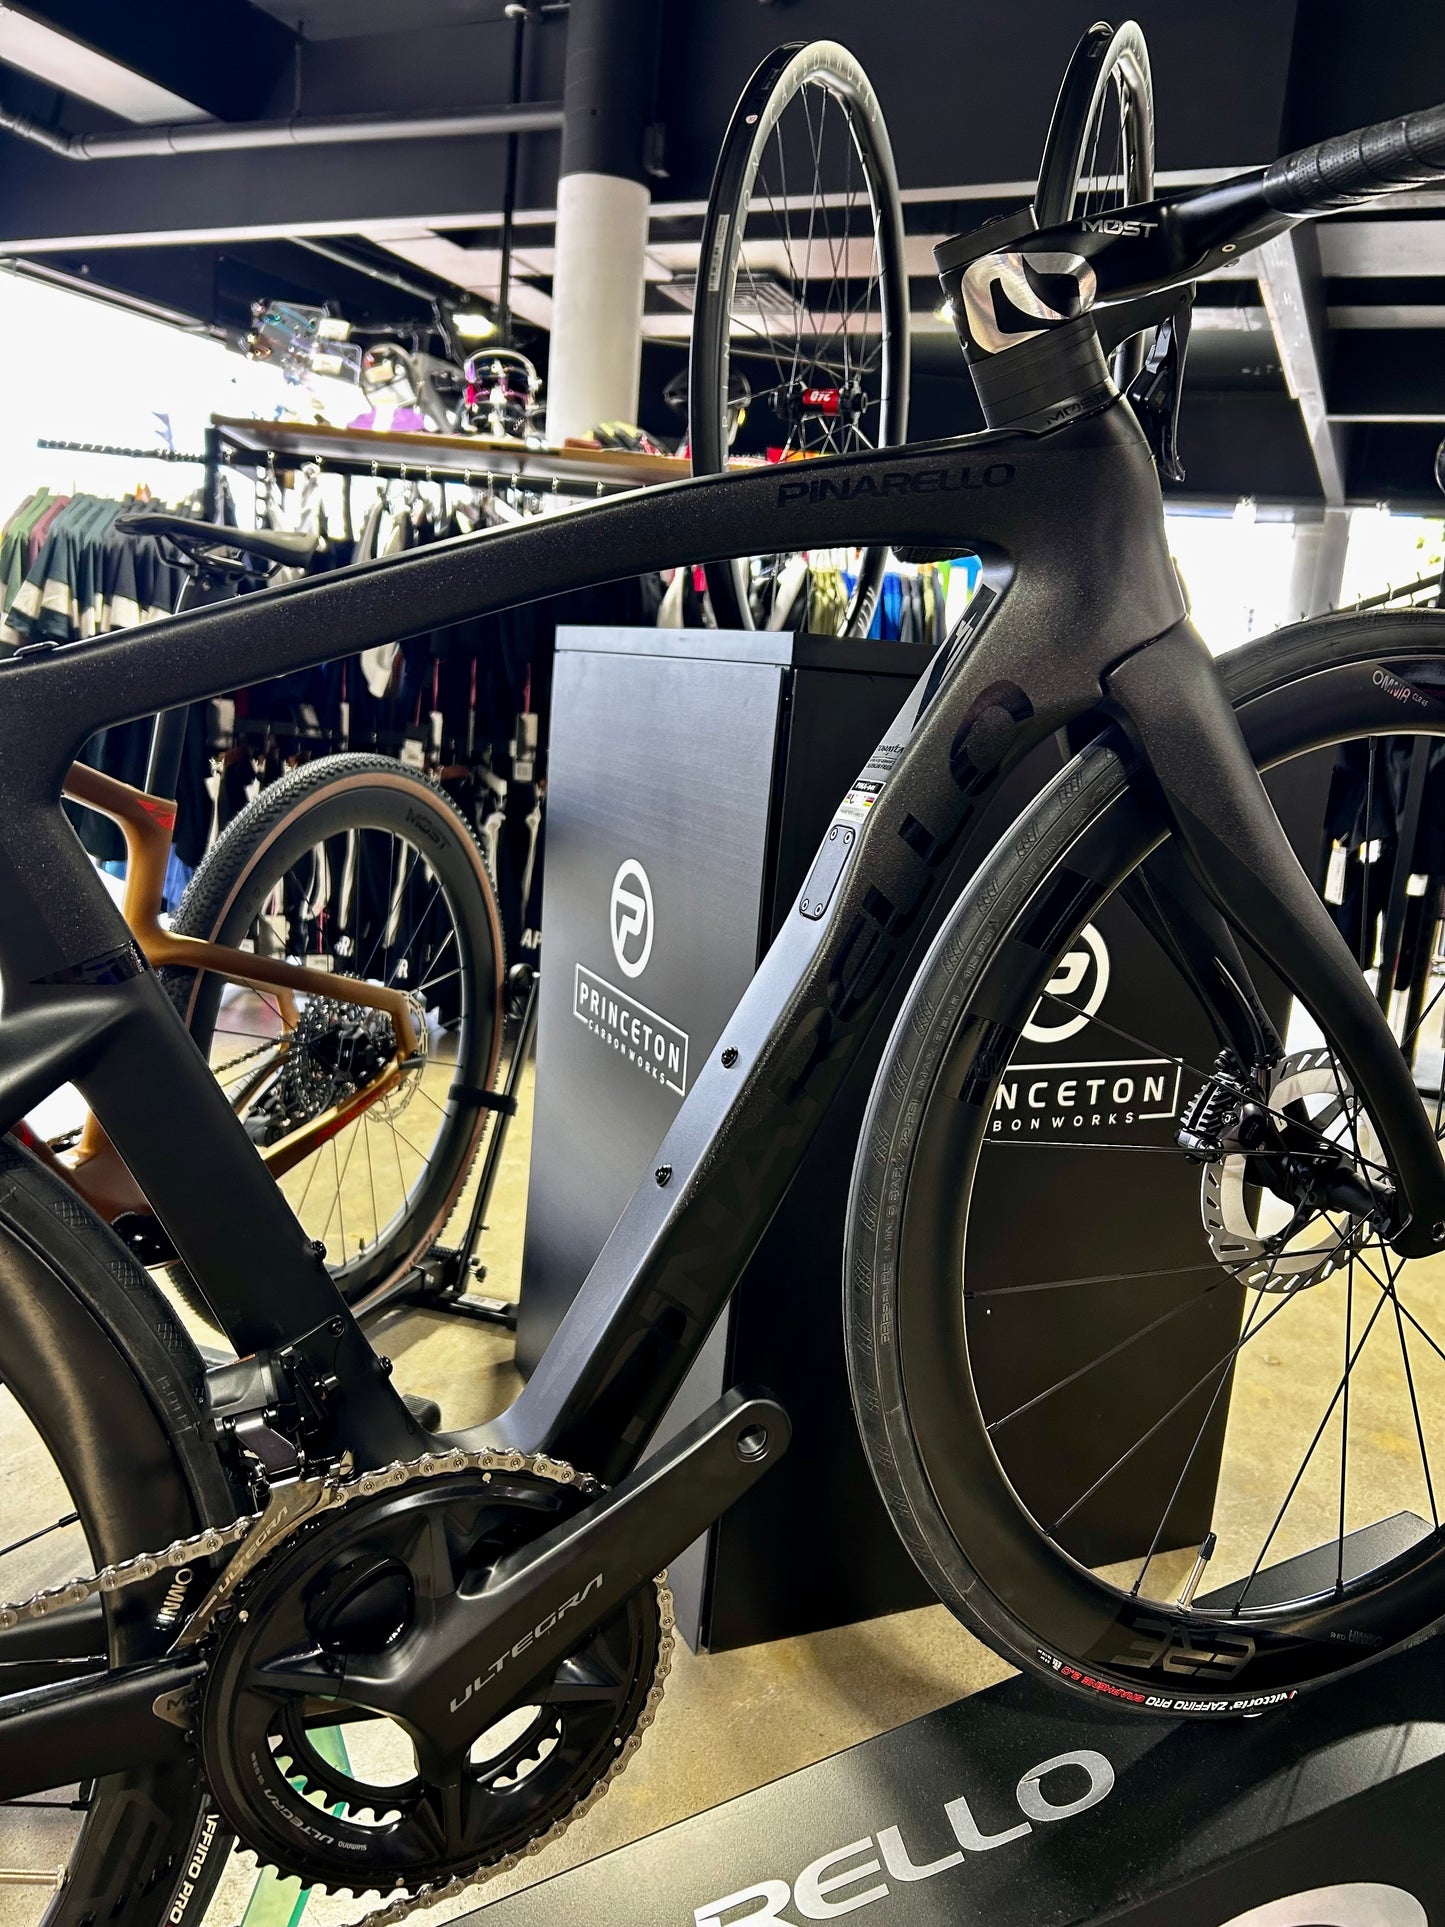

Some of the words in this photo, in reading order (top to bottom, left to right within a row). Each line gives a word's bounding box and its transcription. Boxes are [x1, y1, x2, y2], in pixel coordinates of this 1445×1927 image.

[776, 462, 1017, 509] PINARELLO
[1372, 669, 1411, 704] OMNIA
[578, 981, 681, 1074] PRINCETON
[880, 1262, 893, 1346] PRESSURE
[916, 1049, 938, 1089] MAX
[218, 1505, 289, 1594] ULTEGRA
[155, 1567, 195, 1624] OMNI
[450, 1572, 604, 1714] ULTEGRA
[1081, 1674, 1146, 1704] GRAPHENE
[1145, 1696, 1173, 1710] PRO
[1173, 1700, 1227, 1712] ZAFFIRO
[264, 1788, 335, 1846] ULTEGRA
[169, 1880, 195, 1925] PRO
